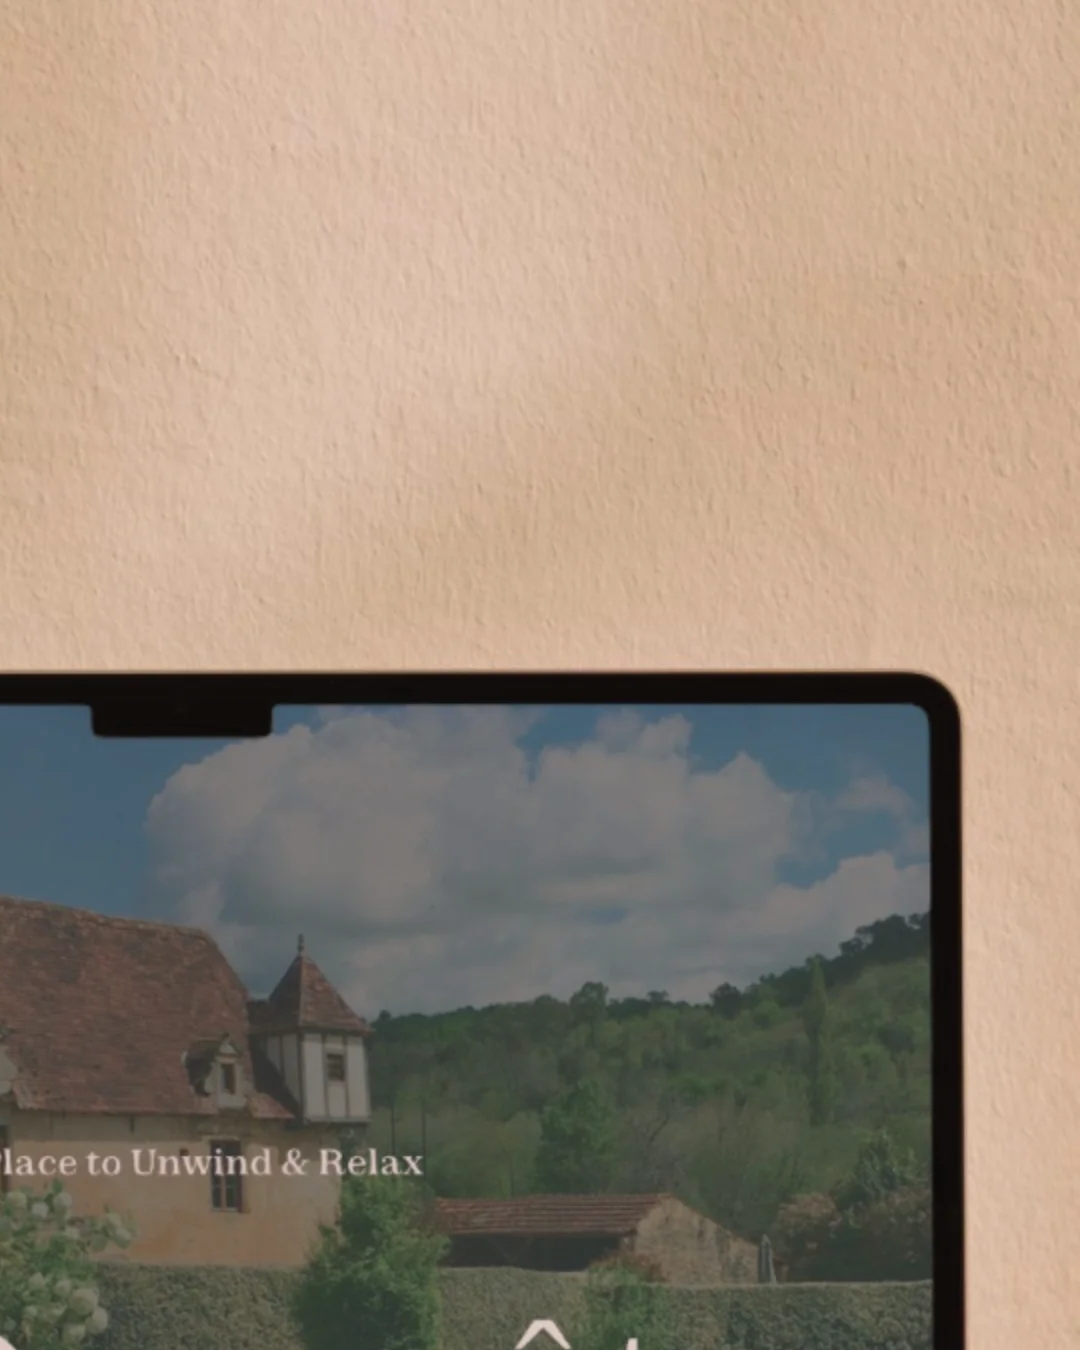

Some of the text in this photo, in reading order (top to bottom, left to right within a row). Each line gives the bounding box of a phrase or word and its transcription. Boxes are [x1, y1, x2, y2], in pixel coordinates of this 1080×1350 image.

[88, 1152, 121, 1176] to
[131, 1148, 272, 1176] Unwind
[281, 1149, 310, 1176] &
[320, 1148, 424, 1176] Relax
